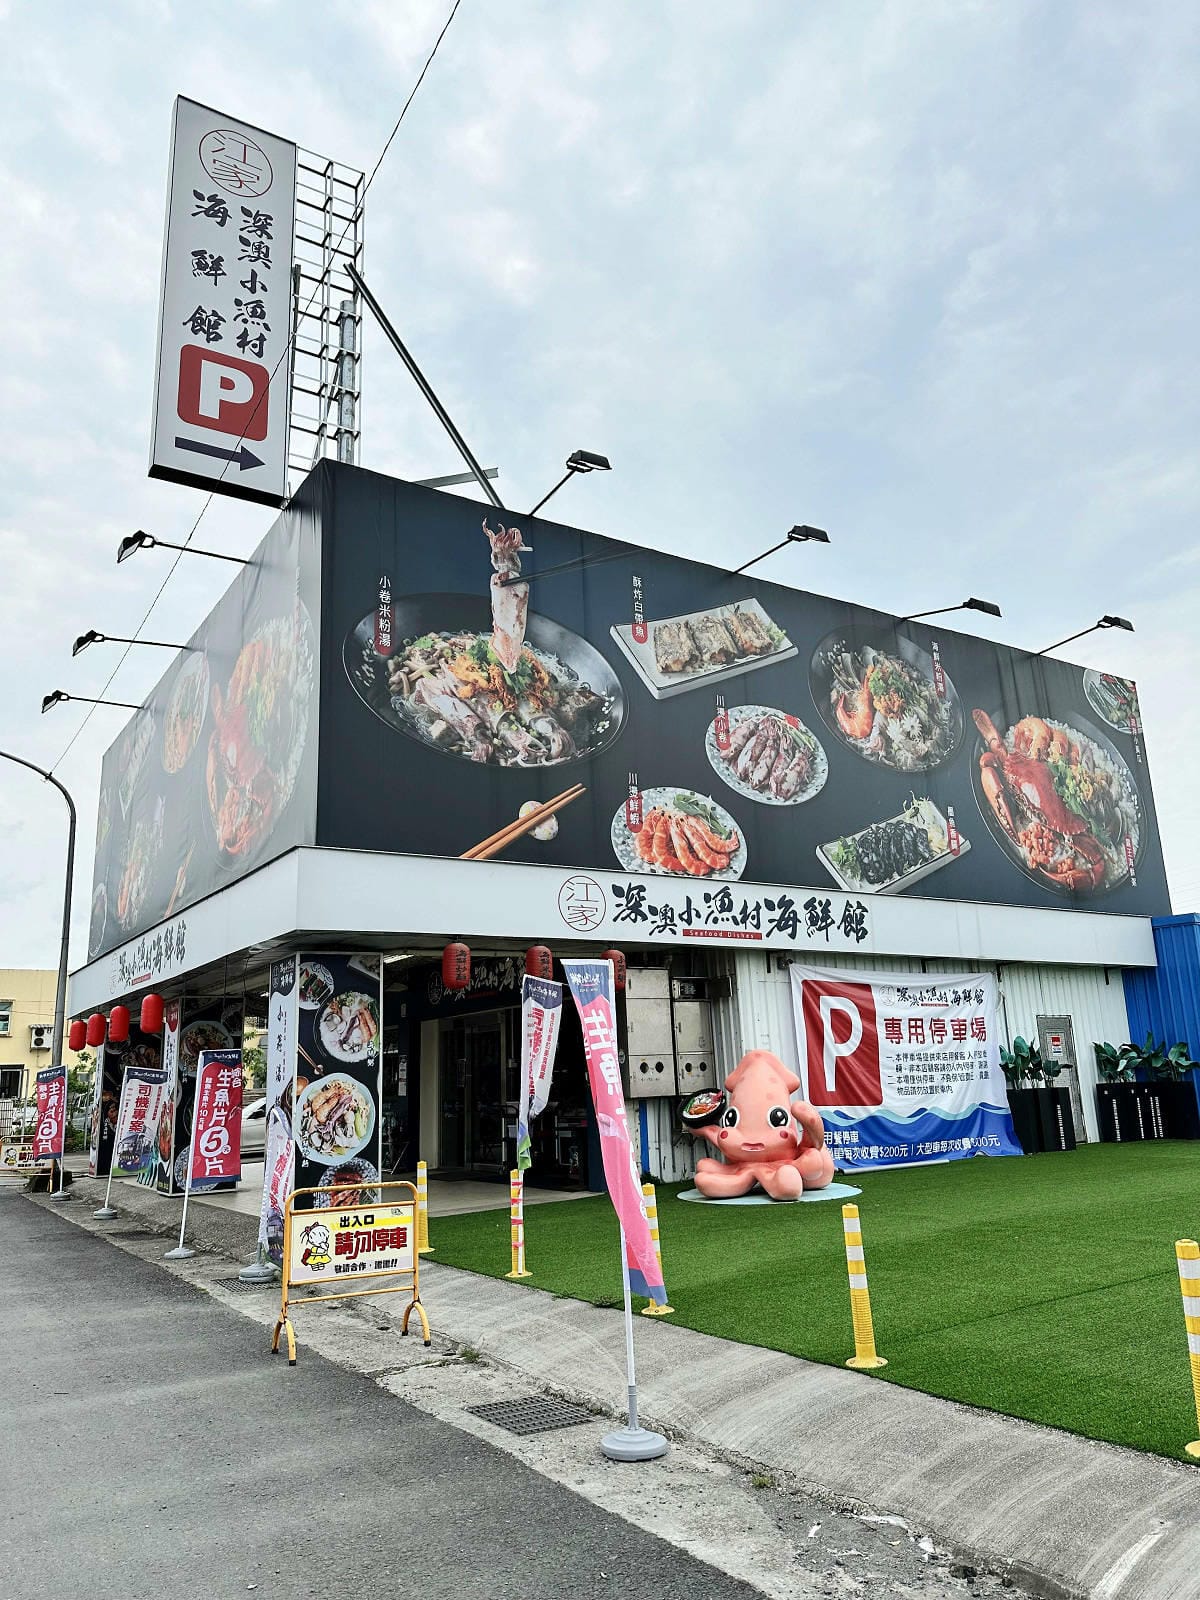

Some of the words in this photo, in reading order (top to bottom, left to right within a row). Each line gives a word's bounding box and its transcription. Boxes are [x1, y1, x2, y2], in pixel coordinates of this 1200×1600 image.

[210, 131, 263, 190] 江家
[182, 189, 233, 345] 海鮮館
[233, 205, 274, 359] 深澳小漁村
[198, 359, 255, 421] P
[379, 575, 391, 647] 小卷米粉湯
[565, 881, 599, 926] 江家
[611, 881, 870, 944] 深澳小漁村海鮮館
[819, 995, 863, 1092] P
[883, 1016, 988, 1045] 專用停車場
[128, 1084, 152, 1133] 司機專案
[208, 1068, 231, 1127] 生魚片
[205, 1129, 223, 1152] 5
[205, 1156, 224, 1176] 片
[334, 1226, 408, 1260] 請勿停車
[339, 1214, 375, 1228] 出入口
